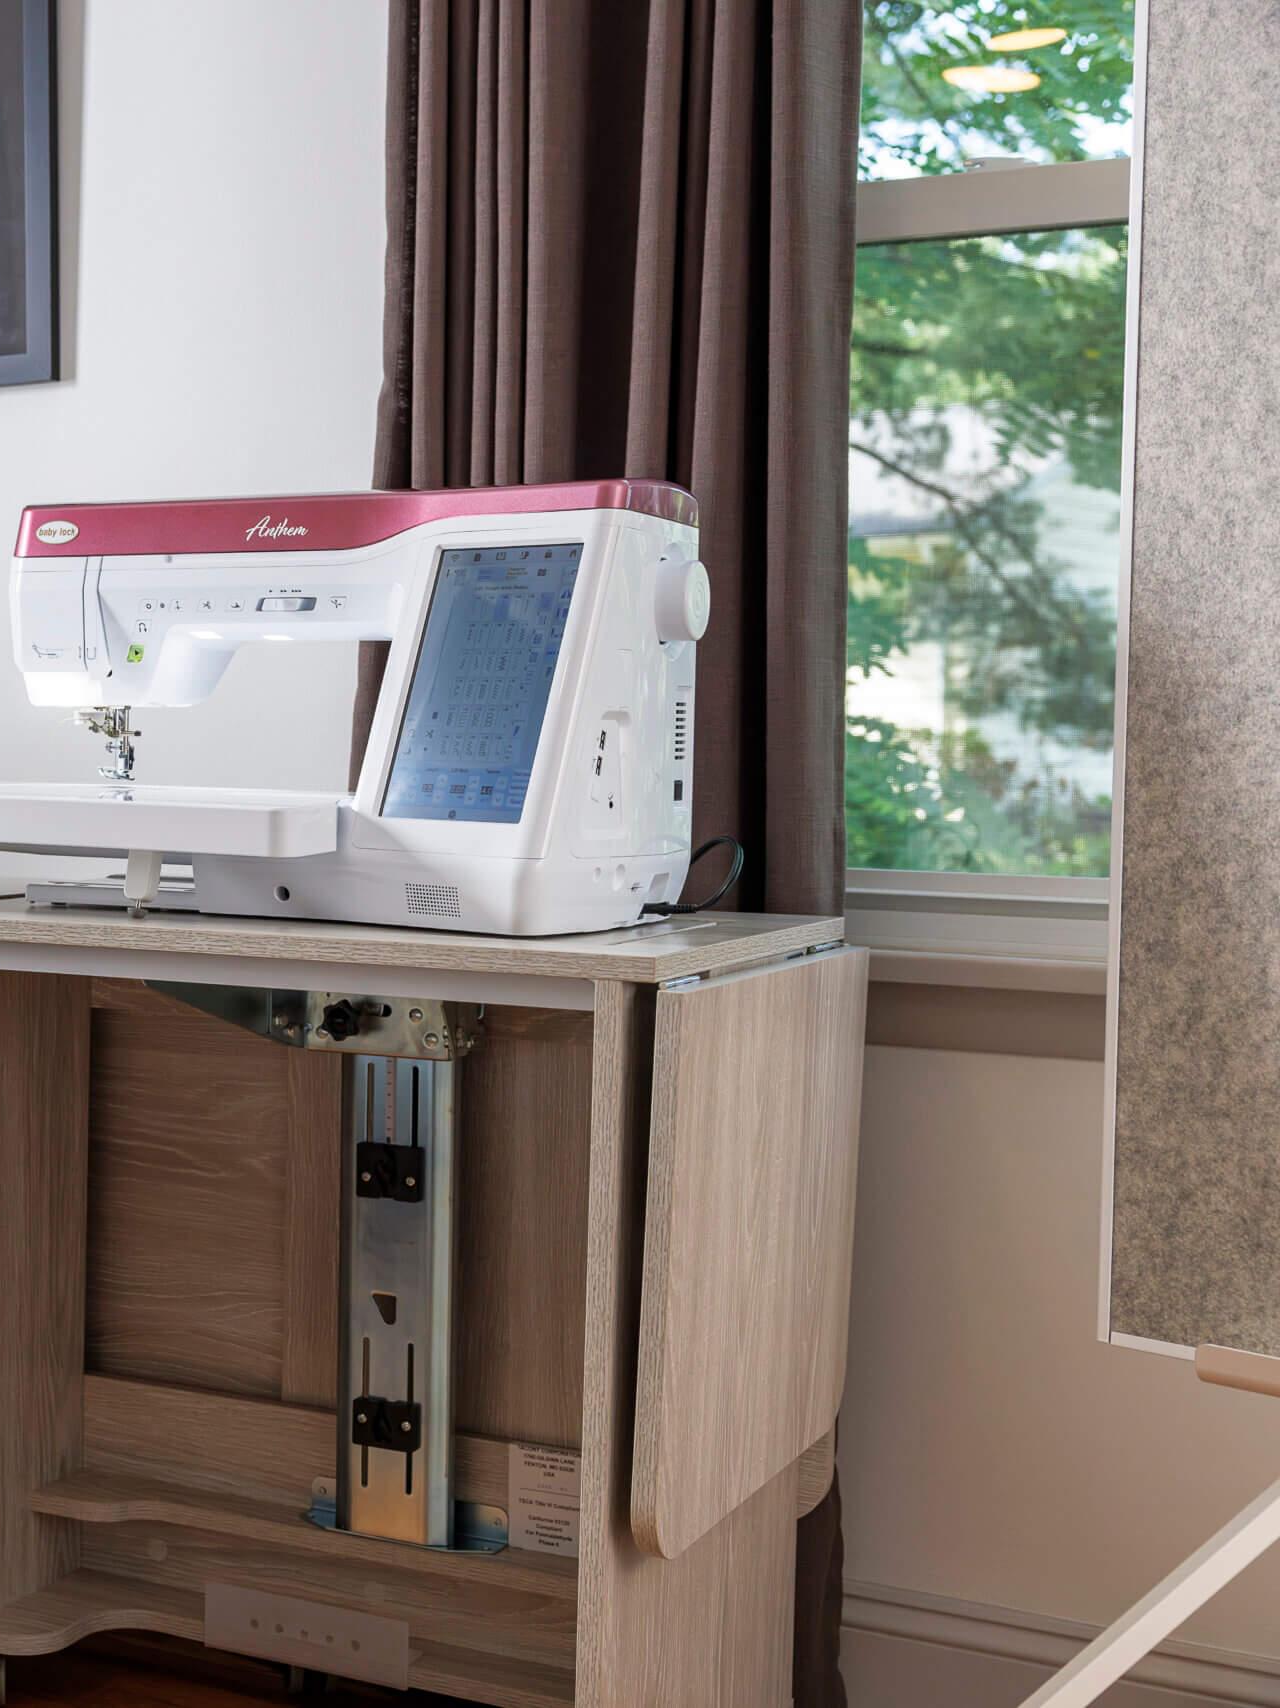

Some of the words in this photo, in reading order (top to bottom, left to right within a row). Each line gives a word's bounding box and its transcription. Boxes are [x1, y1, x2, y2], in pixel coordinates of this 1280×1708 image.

[38, 526, 57, 538] baby
[59, 526, 76, 537] lock
[245, 515, 309, 541] Anthem
